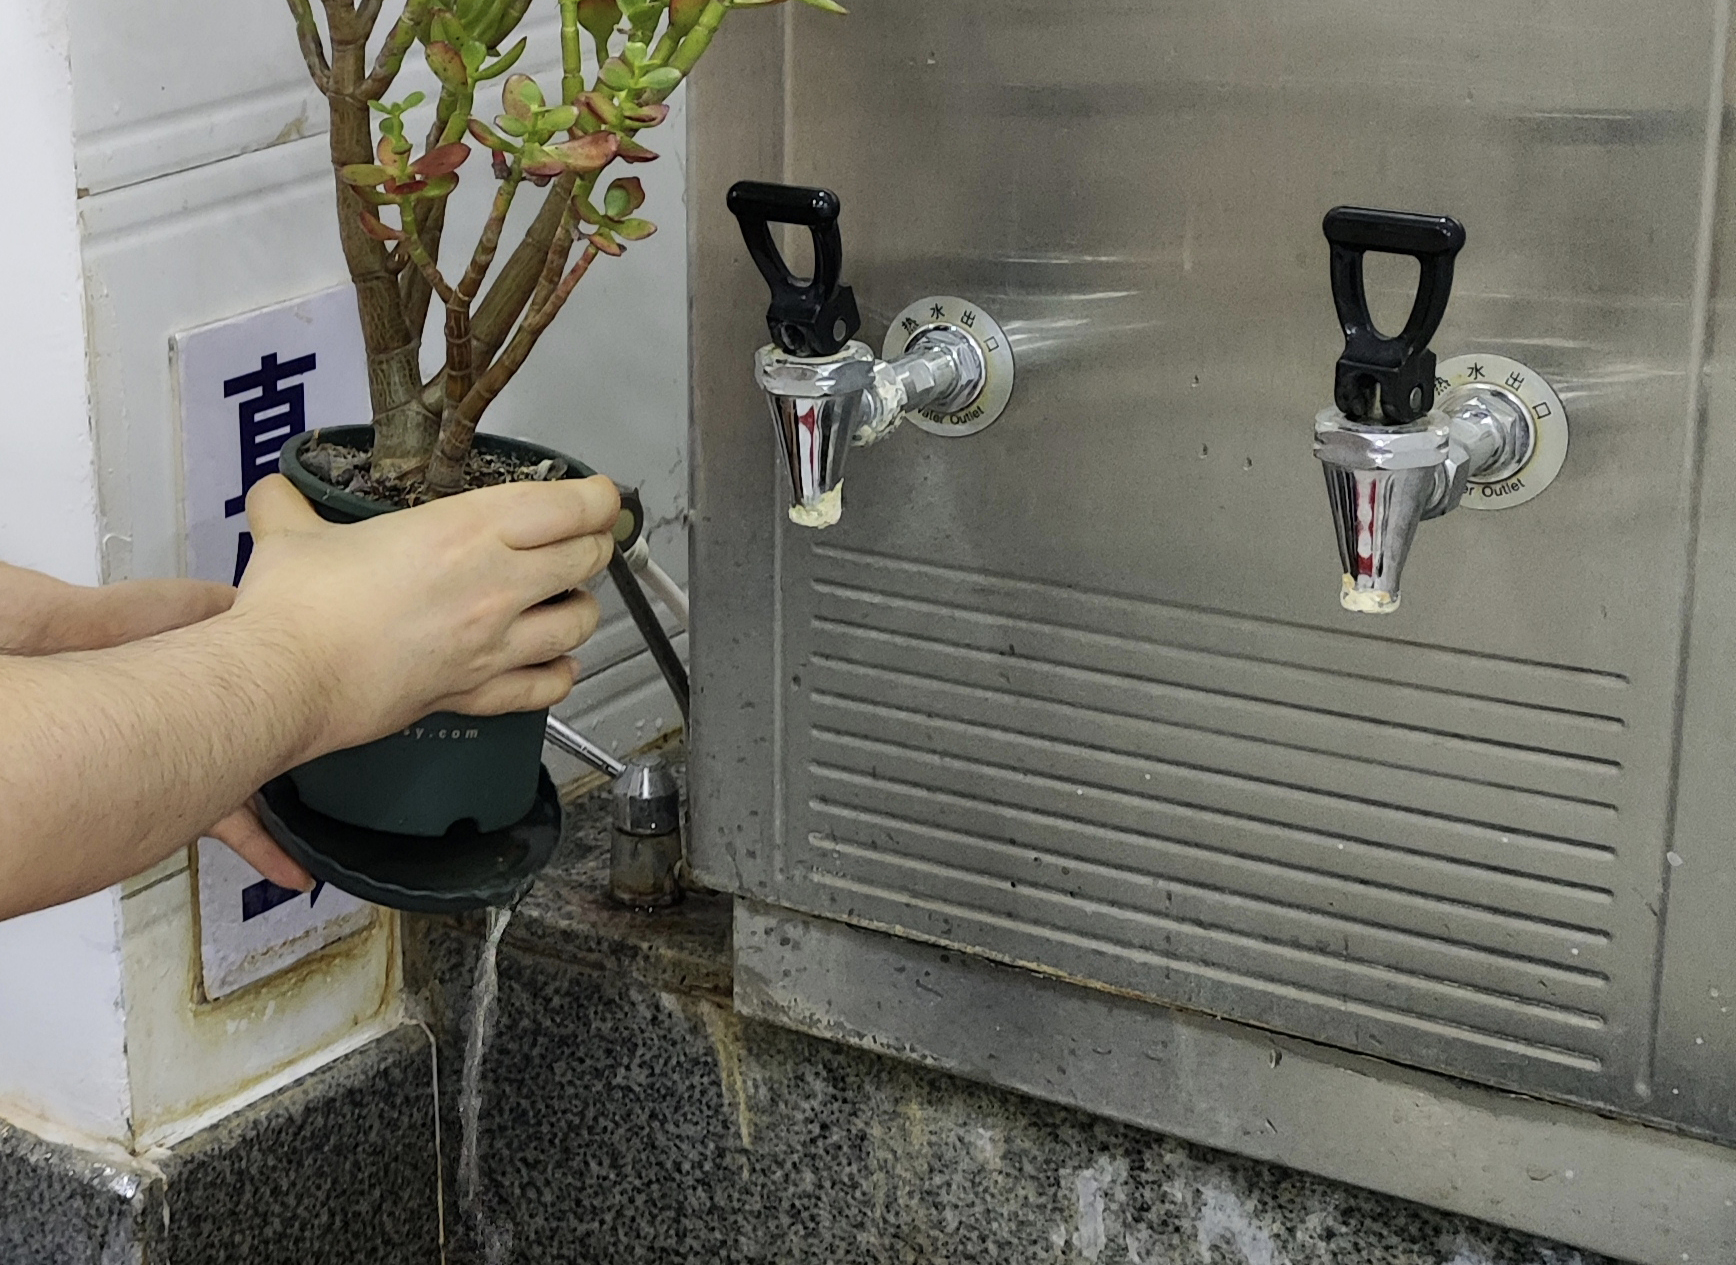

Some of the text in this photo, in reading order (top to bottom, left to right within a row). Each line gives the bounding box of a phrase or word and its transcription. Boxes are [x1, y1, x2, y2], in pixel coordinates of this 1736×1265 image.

[902, 303, 999, 352] 热水出口
[950, 405, 984, 425] Outlet
[1482, 478, 1525, 497] Outlet
